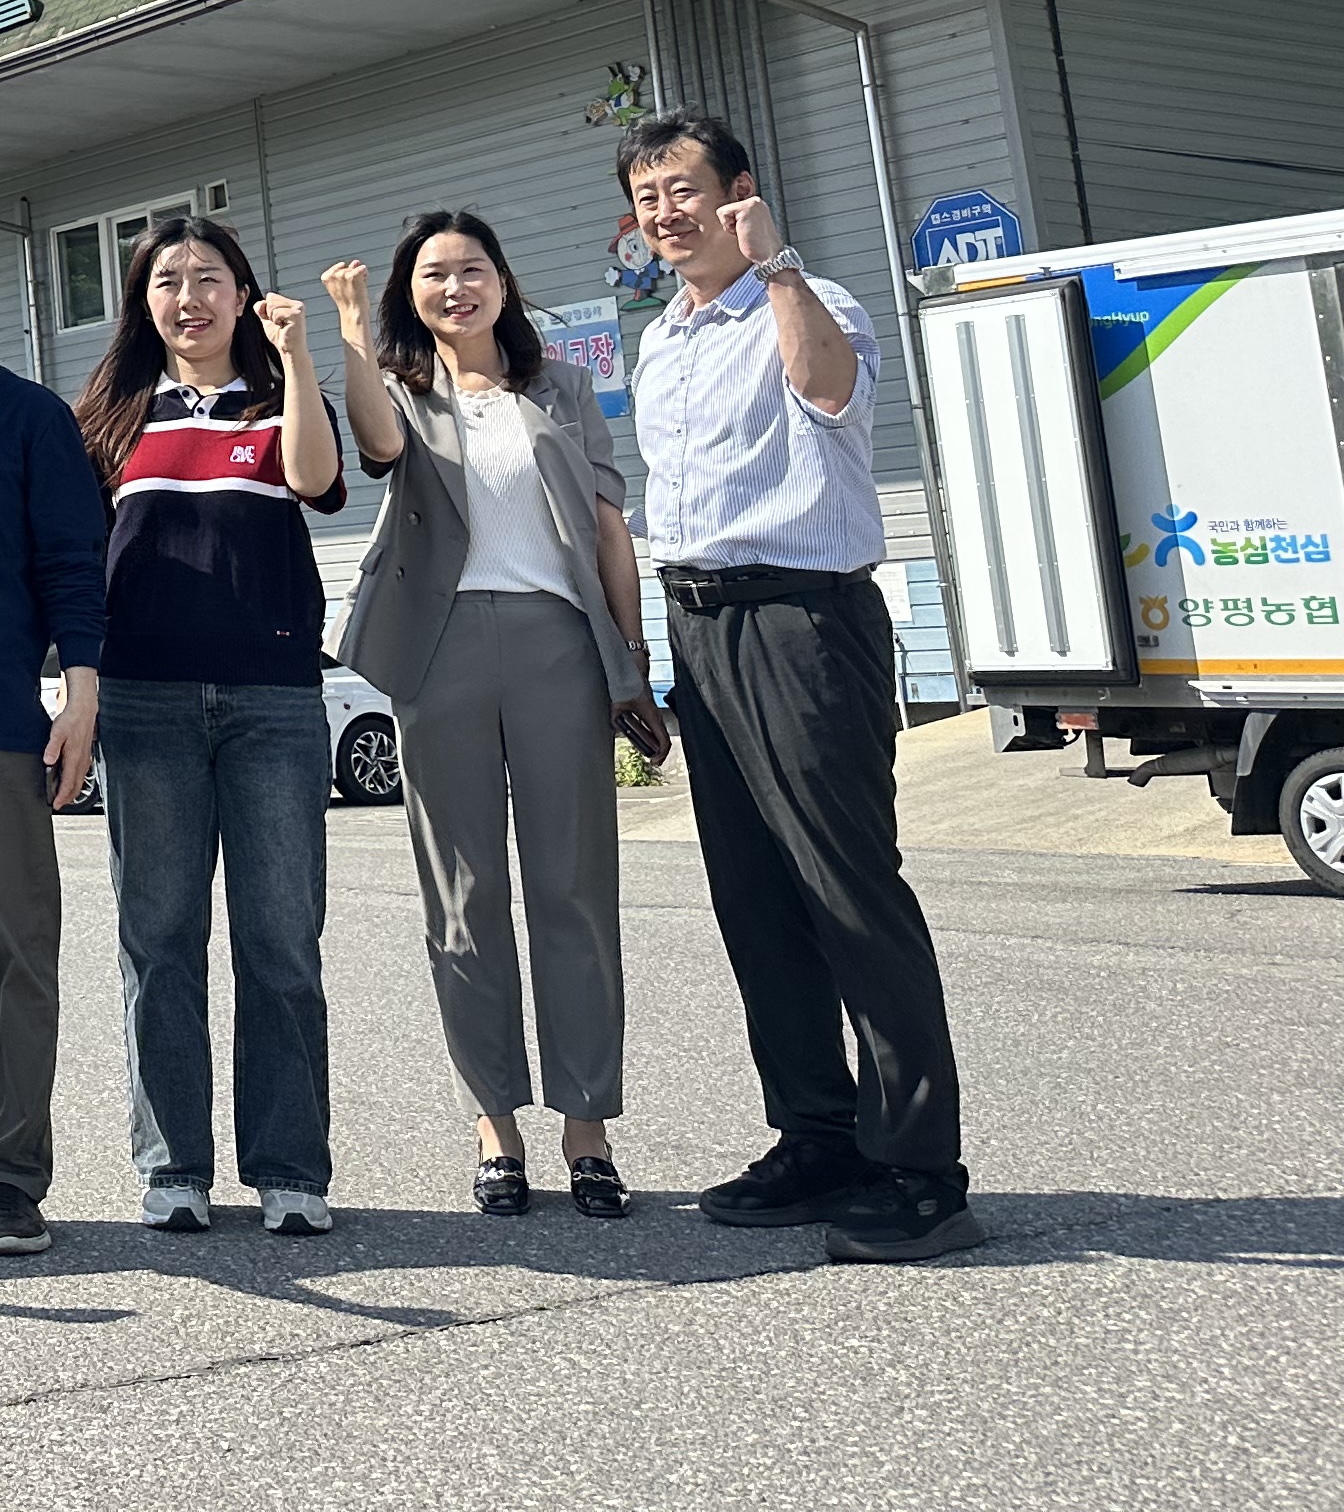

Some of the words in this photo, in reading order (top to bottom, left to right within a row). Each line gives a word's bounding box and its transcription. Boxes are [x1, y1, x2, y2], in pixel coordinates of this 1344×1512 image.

[937, 227, 1003, 267] ADT
[1208, 519, 1241, 533] 국민과
[1243, 518, 1289, 532] 함께하는
[1210, 533, 1332, 566] 농심천심
[1178, 595, 1340, 628] 양평농협
